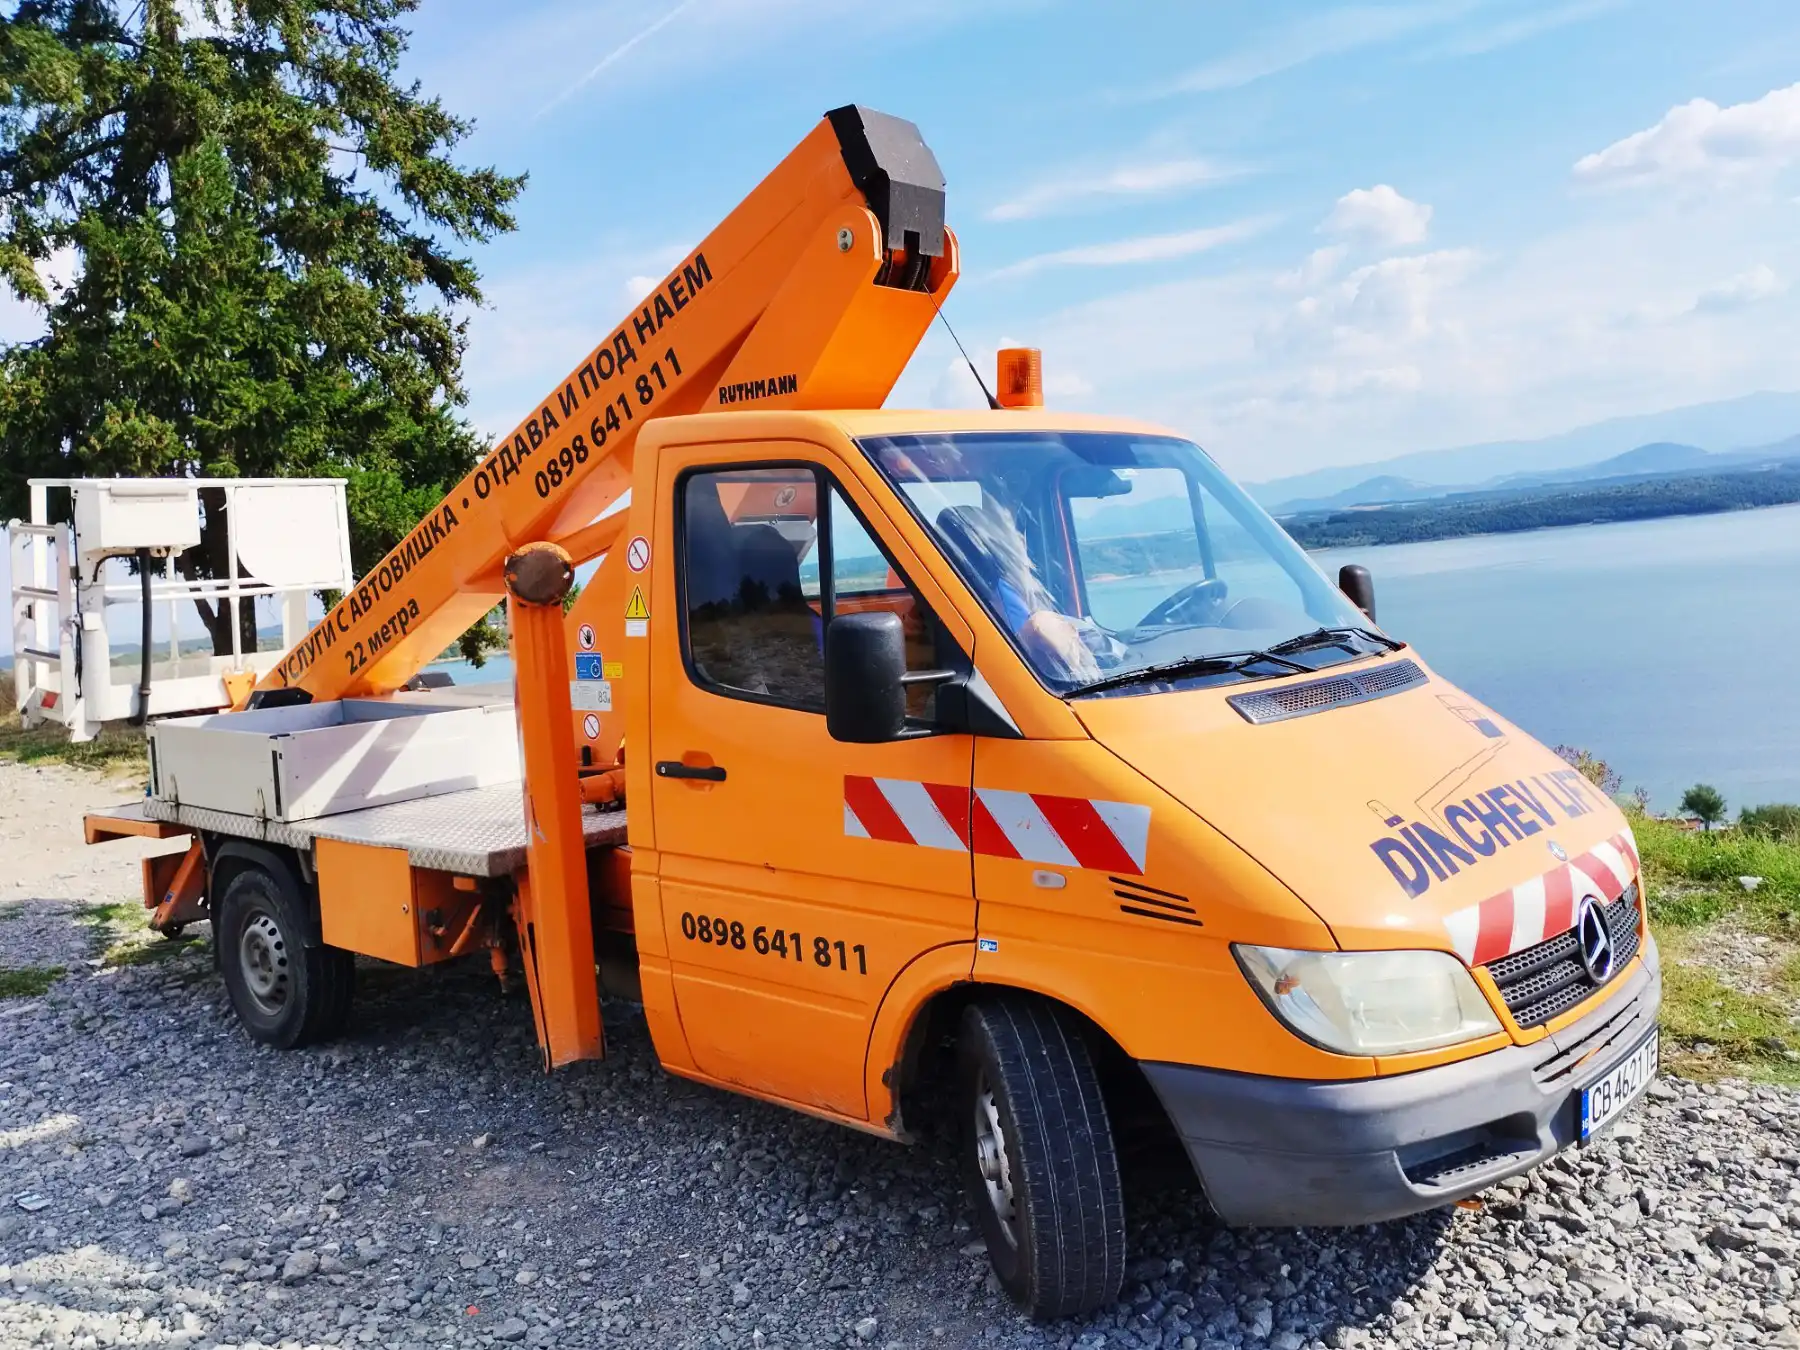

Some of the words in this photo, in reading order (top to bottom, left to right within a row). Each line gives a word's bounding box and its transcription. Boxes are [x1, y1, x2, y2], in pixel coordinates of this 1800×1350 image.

[535, 435, 589, 498] 0898
[591, 393, 633, 447] 641
[635, 347, 683, 405] 811
[718, 374, 797, 405] RUTHMANN
[277, 620, 337, 687] УСЛУГИ
[336, 607, 350, 632] С
[350, 504, 460, 624] АВТОВИШКА
[474, 405, 560, 499] ОТДАВА
[557, 383, 580, 420] И
[578, 329, 638, 399] ПОД
[632, 252, 714, 346] НАЕМ
[344, 642, 368, 676] 22
[367, 598, 421, 660] метра
[1369, 779, 1556, 899] DINCHEV
[1530, 769, 1608, 818] LIFT
[681, 912, 746, 950] 0898
[753, 925, 803, 962] 641
[813, 936, 867, 975] 811
[1614, 1052, 1642, 1104] 4621
